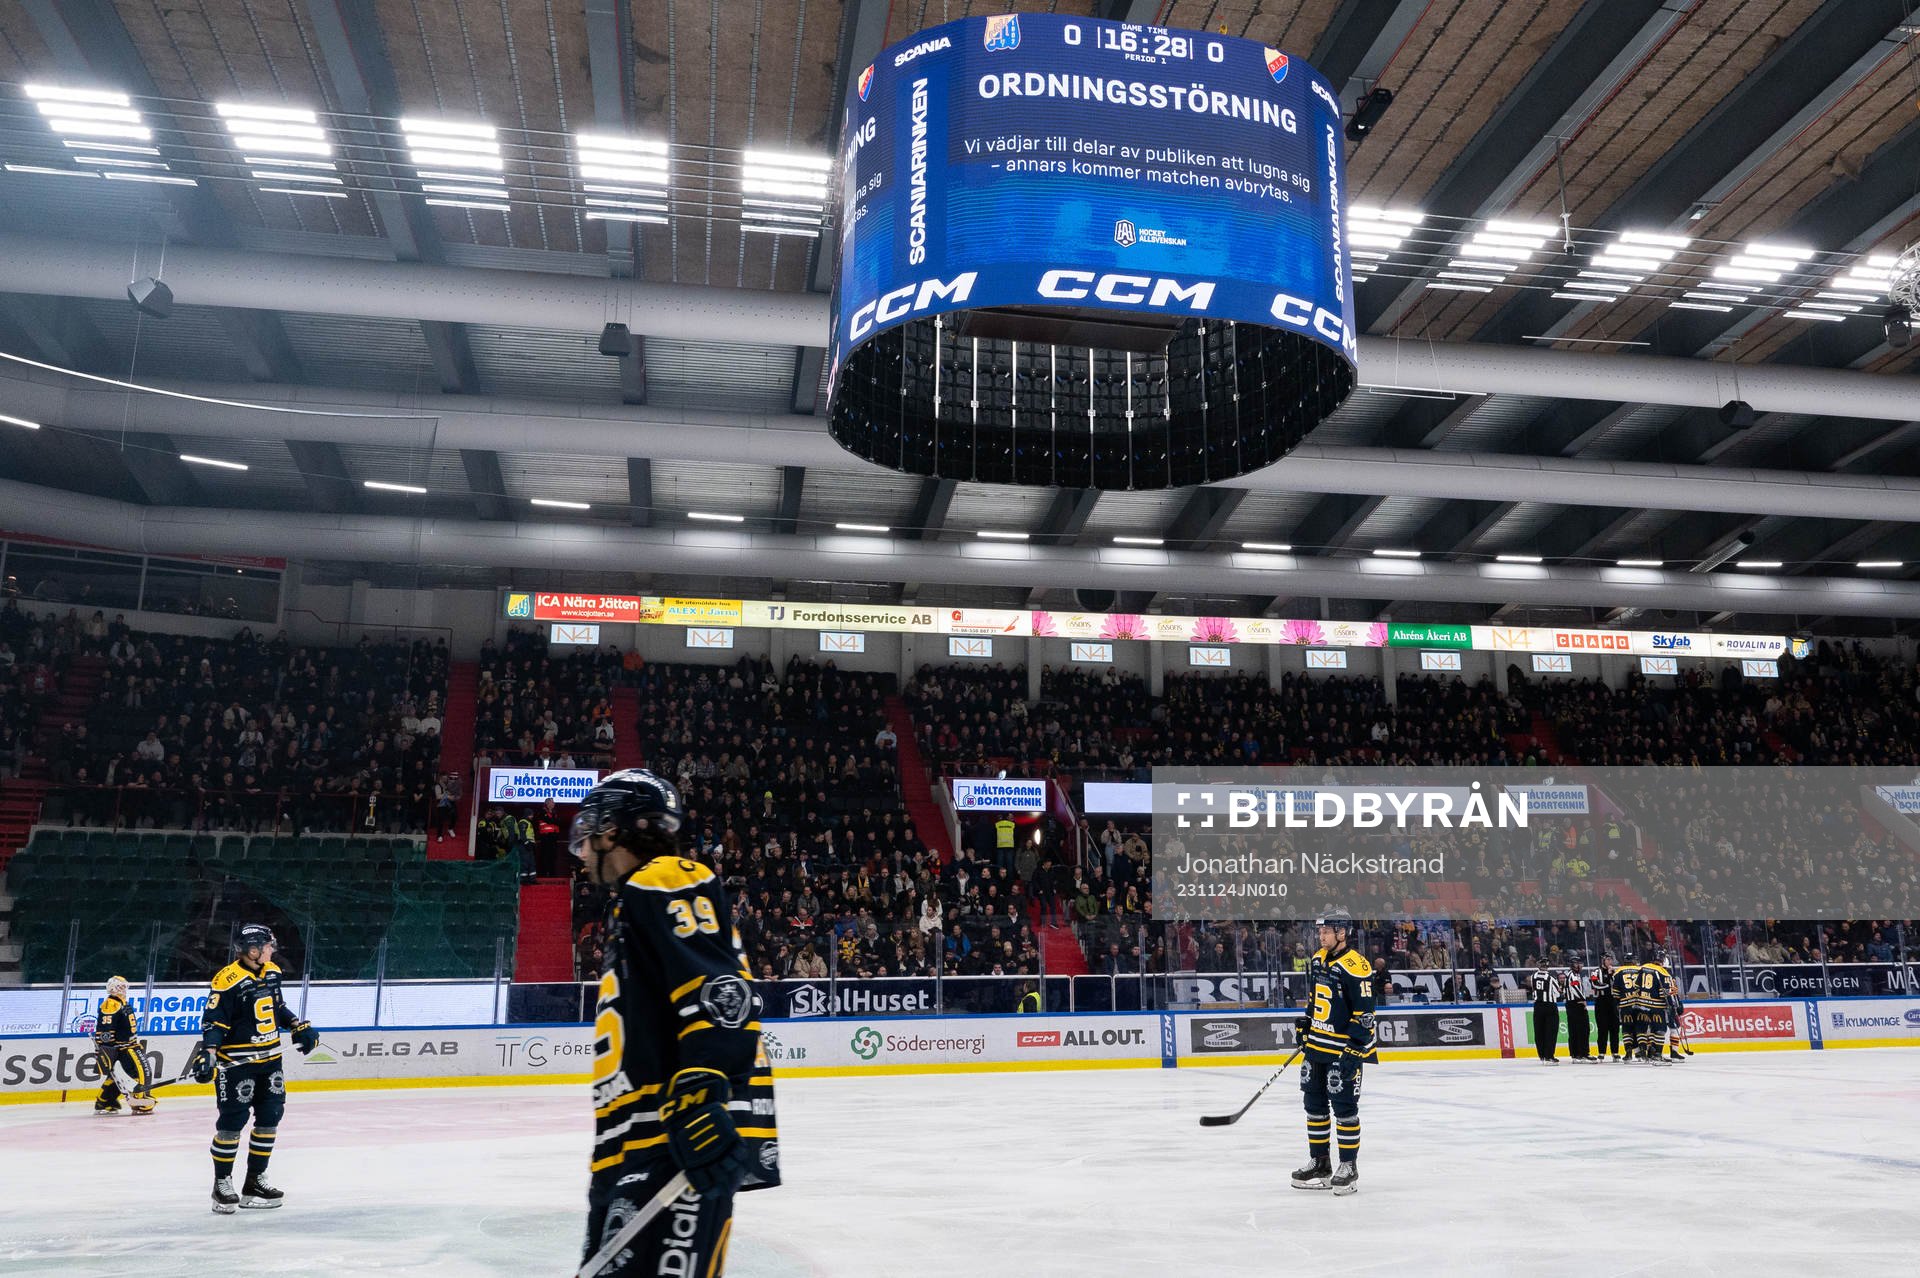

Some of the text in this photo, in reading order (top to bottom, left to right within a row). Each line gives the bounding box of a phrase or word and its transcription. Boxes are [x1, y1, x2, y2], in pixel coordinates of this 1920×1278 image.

[1147, 26, 1168, 35] TIME
[894, 36, 952, 67] SCANIA
[1064, 24, 1224, 63] 0 0
[1104, 28, 1188, 58] 16:28
[1125, 53, 1156, 63] PERIOD
[978, 72, 1297, 134] ORDNINGSSTÖRNING
[909, 77, 929, 266] SCANIARINKEN
[964, 136, 1310, 193] Vi vädjar till delar av publiken att lugna sig
[1006, 159, 1067, 174] annars
[1072, 158, 1141, 180] kommer
[1146, 168, 1220, 188] matchen
[1225, 178, 1293, 203] avbrytas.
[1139, 228, 1166, 238] HOCKEY
[1139, 235, 1187, 247] ALLSVENSKAN
[1036, 269, 1217, 310] CCM
[849, 271, 979, 342] CCM
[1270, 293, 1358, 363] CCM
[537, 595, 639, 610] ICA Nära Jätten
[668, 607, 697, 615] ALEX
[768, 606, 932, 625] TJ Fordonsservice AB
[1393, 628, 1467, 642] Ahréns Åkeri AB
[1558, 635, 1628, 648] CRAMO
[1726, 640, 1781, 650] ROVALIN AB
[513, 772, 593, 787] HÅLTAGARNA
[973, 783, 1042, 796] HÅLTAGARNA
[977, 796, 1042, 807] BORRTEKNIK
[666, 896, 720, 939] 39
[1359, 981, 1373, 998] 15
[1535, 980, 1544, 990] 61
[1783, 975, 1860, 990] FÖRETAGEN
[1313, 983, 1333, 1022] S
[254, 995, 277, 1034] S
[1808, 1000, 1821, 1041] CCM
[1845, 1016, 1901, 1028] KYLMONTAGE
[1501, 1007, 1510, 1049] CCM
[1684, 1013, 1793, 1035] SkalHuset.se
[886, 1034, 985, 1055] Söderenergi
[1021, 1029, 1146, 1046] CCM ALL OUT.
[1164, 1014, 1173, 1057] CCM
[342, 1041, 459, 1057] J.E.G AB
[786, 1047, 807, 1060] AB
